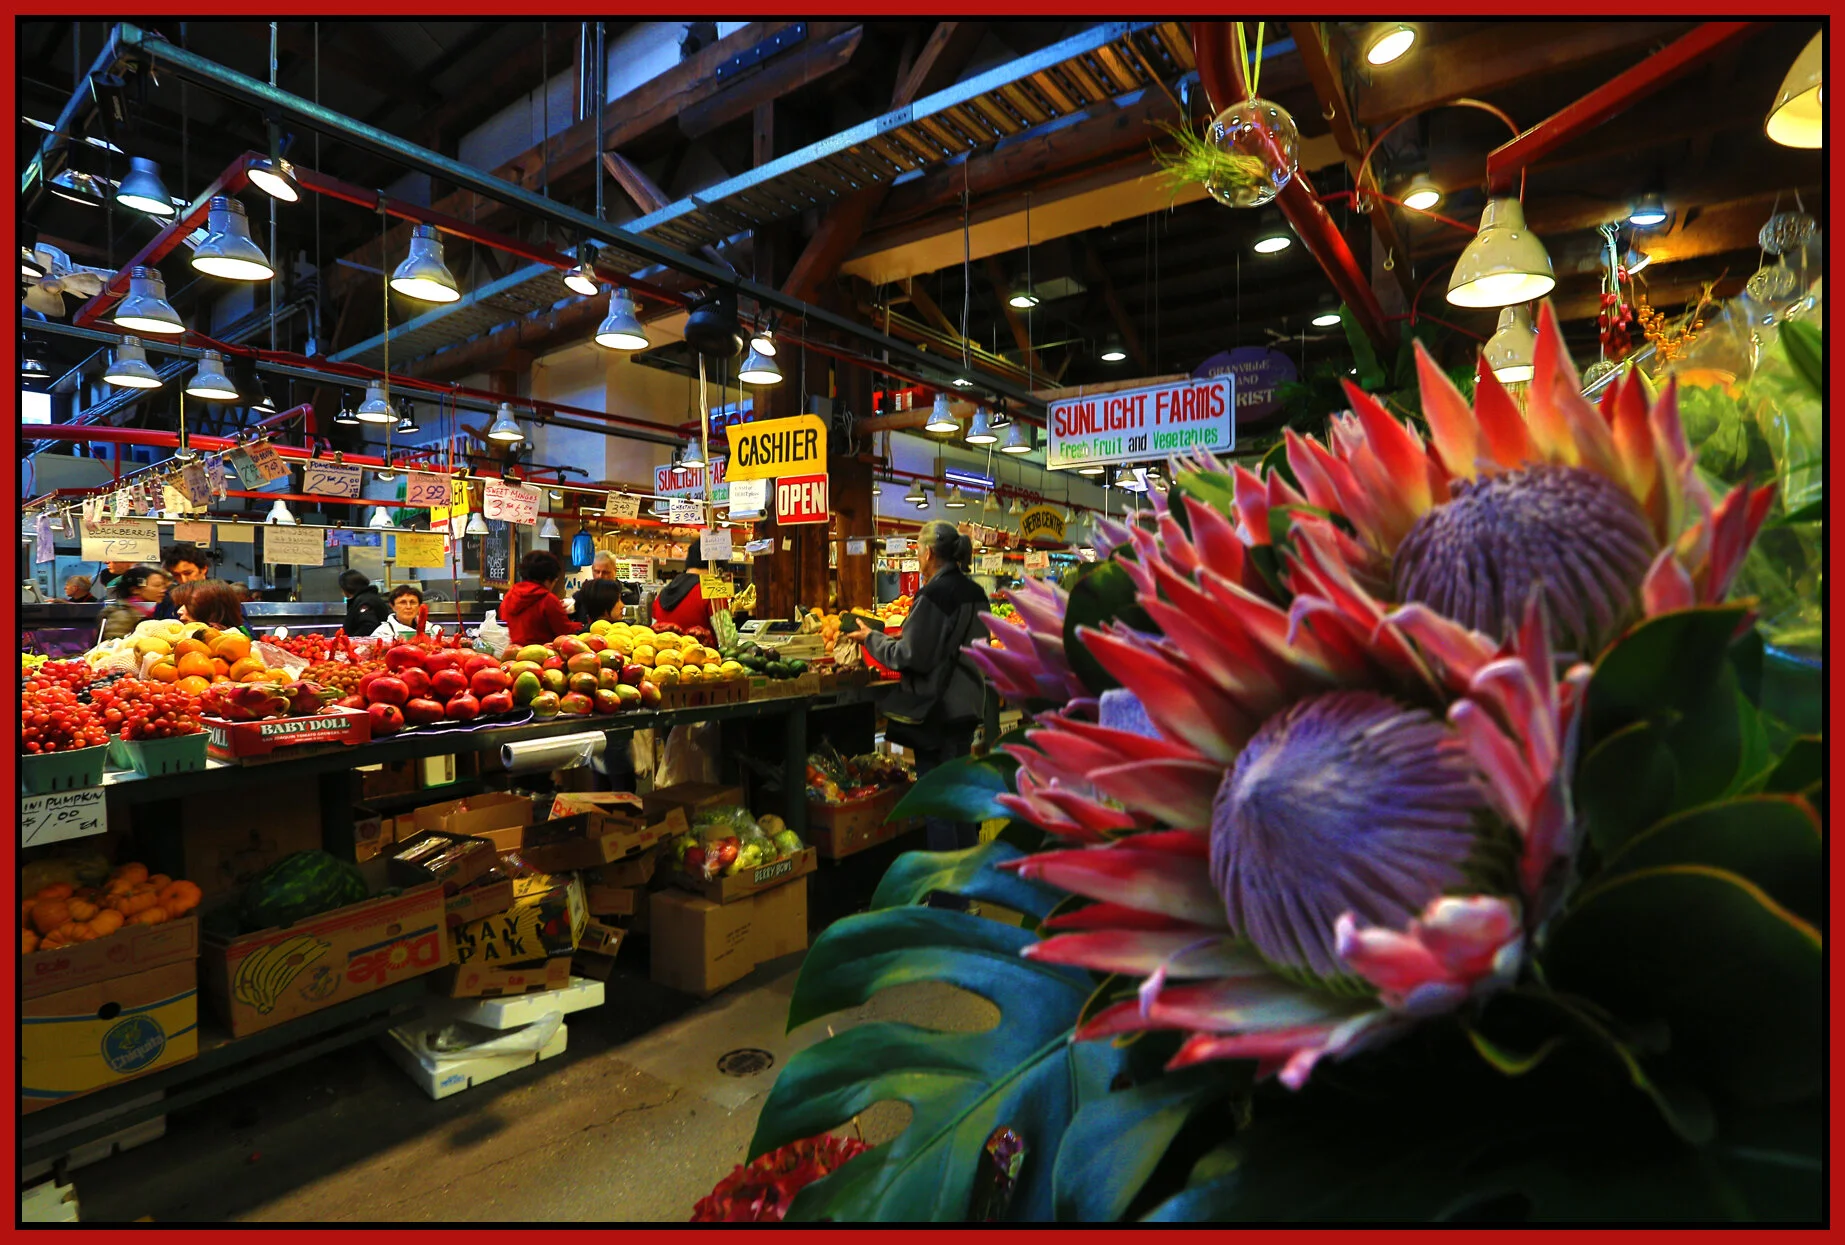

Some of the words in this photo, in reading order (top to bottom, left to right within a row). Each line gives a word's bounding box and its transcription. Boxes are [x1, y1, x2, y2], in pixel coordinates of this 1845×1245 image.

[1208, 360, 1270, 377] GRANVILLE
[1237, 375, 1258, 386] AND
[1236, 388, 1275, 407] RIST
[1055, 395, 1147, 437] SUNLIGHT
[1155, 384, 1225, 426] FARMS
[738, 429, 818, 467] CASHIER
[1060, 442, 1089, 460] Fresh
[1093, 437, 1123, 457] Fruit
[1128, 434, 1148, 453] and
[1153, 428, 1219, 450] Vegetables
[307, 473, 327, 492] 2
[326, 476, 349, 495] 5
[658, 467, 703, 491] SUNLIGHT
[486, 487, 509, 496] SWEET
[778, 482, 825, 516] OPEN
[491, 499, 503, 517] 3
[89, 527, 157, 538] BLACKBERRIES
[1022, 511, 1041, 537] HERB
[1041, 511, 1063, 537] CENTRE
[102, 539, 138, 556] 7.99
[487, 554, 504, 568] ROAST
[489, 568, 505, 579] BEEF
[260, 720, 309, 736] BABY
[310, 717, 351, 731] DOLL
[274, 732, 296, 741] JOAQUIN
[297, 731, 316, 739] TOMATO
[24, 801, 42, 811] INI
[45, 791, 105, 811] PUMPKIN
[754, 862, 776, 883] BERRY
[775, 860, 793, 876] BOWL
[453, 915, 520, 945] KAY
[346, 932, 441, 984] Dole
[457, 936, 527, 965] PAK
[110, 1032, 164, 1071] Chiquita
